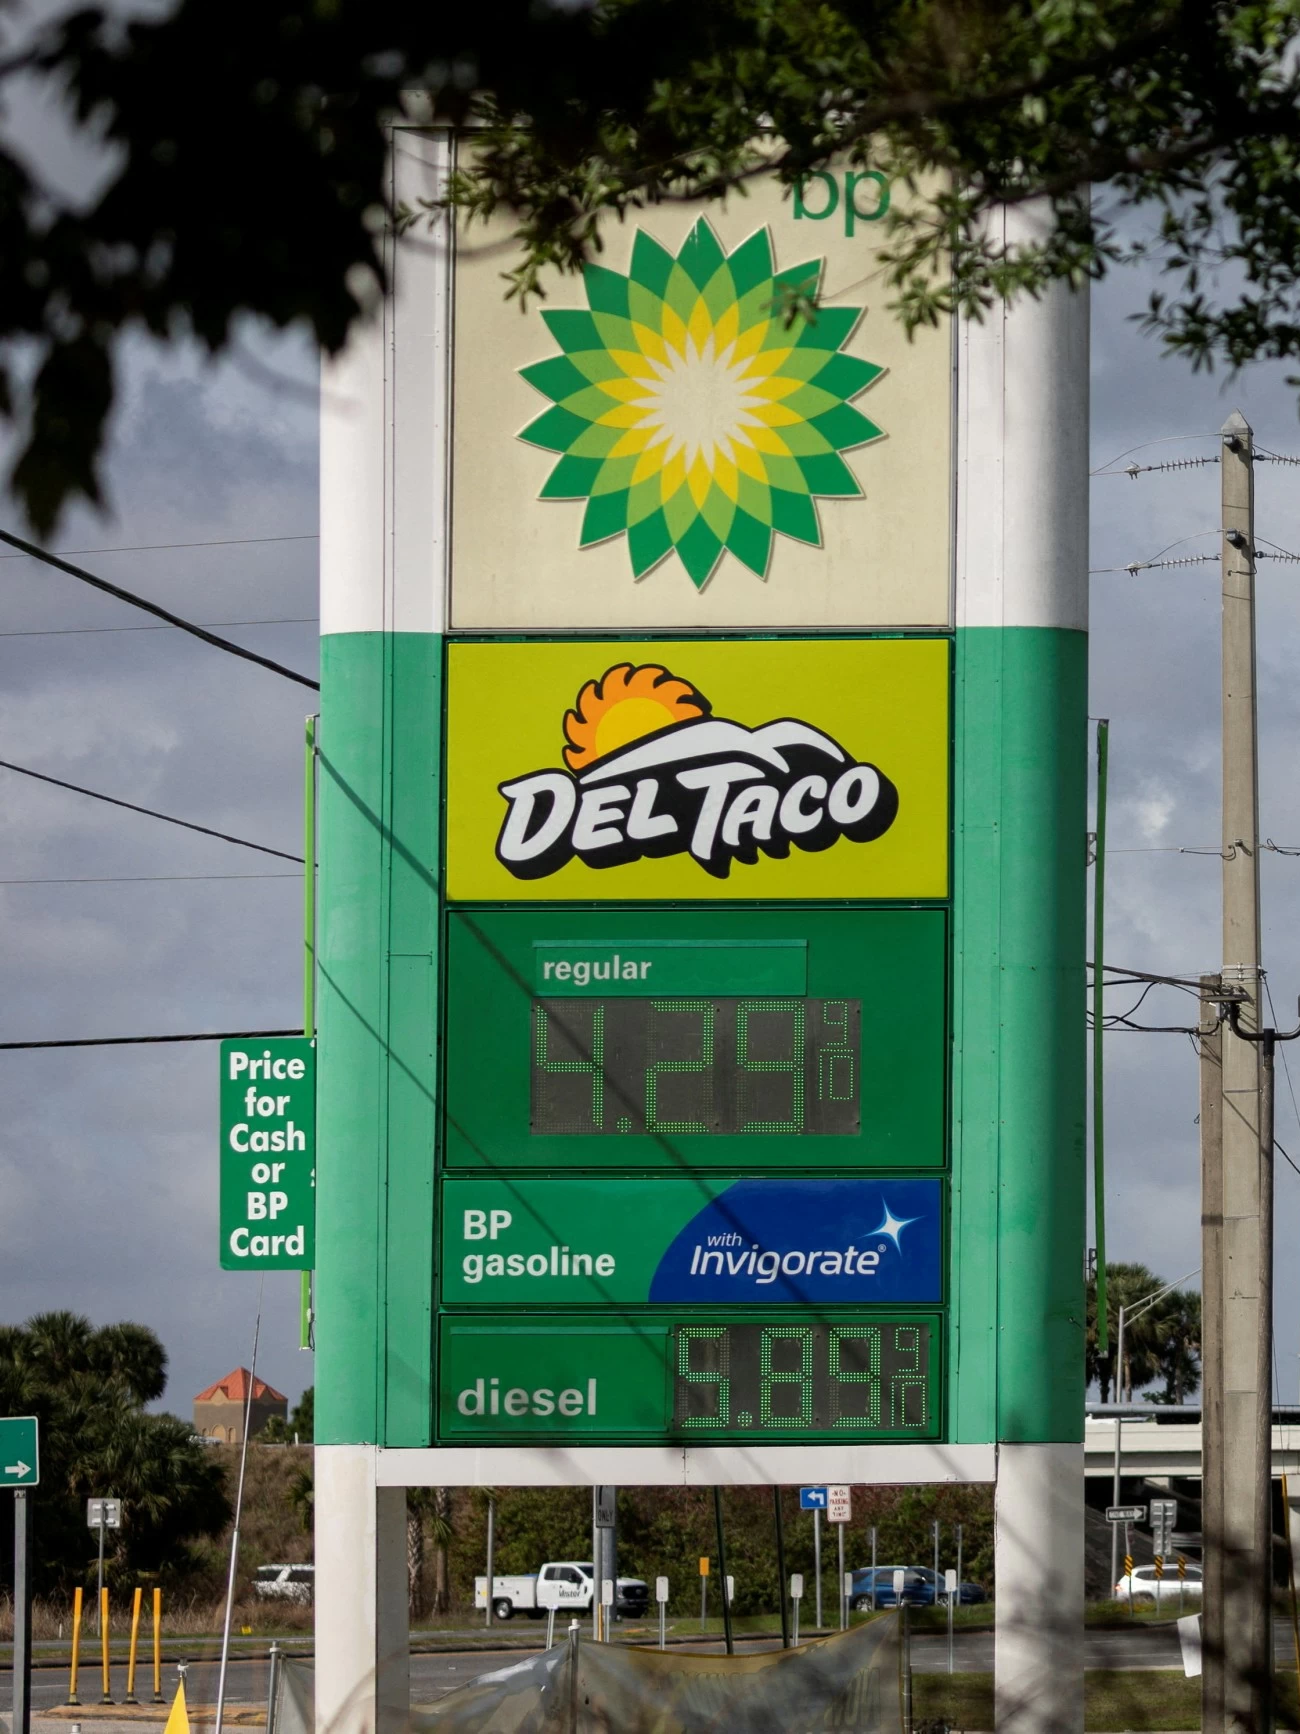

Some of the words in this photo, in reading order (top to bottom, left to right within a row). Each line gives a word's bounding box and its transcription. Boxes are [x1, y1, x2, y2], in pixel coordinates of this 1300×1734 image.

[793, 170, 890, 237] bp
[501, 773, 678, 861] DEL
[676, 762, 880, 860] TACO
[543, 955, 652, 984] regular
[229, 1050, 306, 1080] Price
[536, 1001, 804, 1133] 4.29
[244, 1086, 291, 1117] for
[229, 1121, 306, 1152] Cash
[251, 1163, 286, 1184] or
[247, 1191, 289, 1220] BP
[463, 1209, 513, 1240] BP
[707, 1232, 742, 1247] with
[229, 1225, 305, 1257] Card
[462, 1246, 616, 1284] gasoline
[457, 1378, 597, 1416] diesel
[598, 1509, 614, 1522] ONLY
